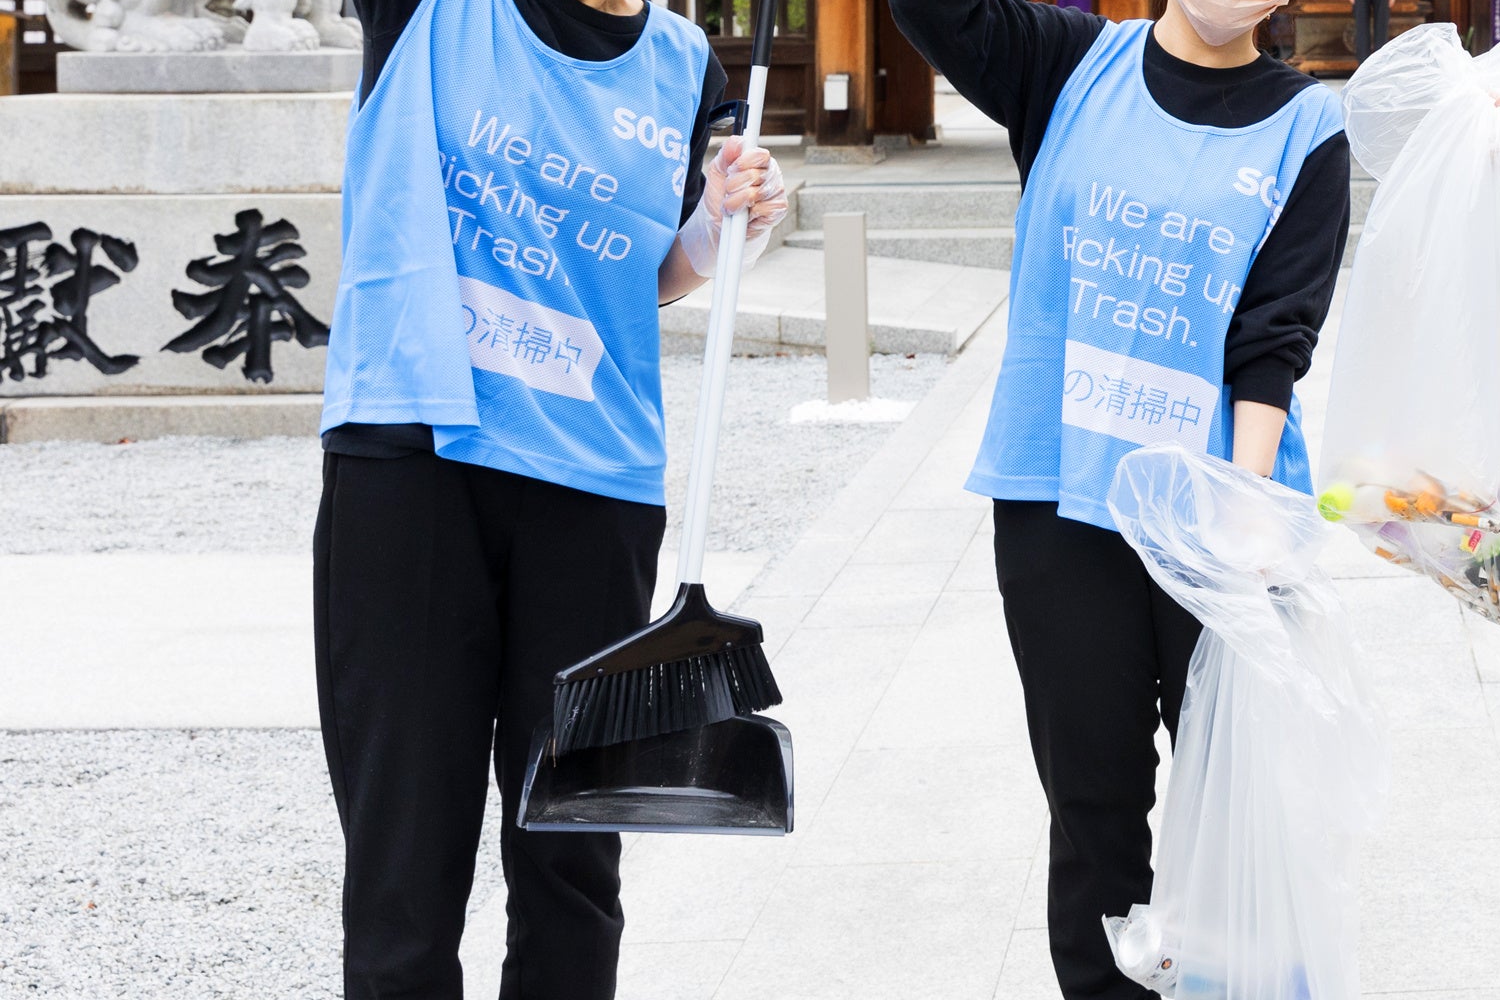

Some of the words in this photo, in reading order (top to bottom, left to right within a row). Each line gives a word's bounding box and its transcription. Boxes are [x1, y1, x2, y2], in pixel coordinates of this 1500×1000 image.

[467, 109, 532, 165] We
[540, 151, 619, 203] are
[576, 220, 632, 262] up
[1088, 181, 1148, 229] We
[1160, 211, 1235, 255] are
[1071, 277, 1198, 347] Trash.
[1064, 369, 1202, 433] の清掃中
